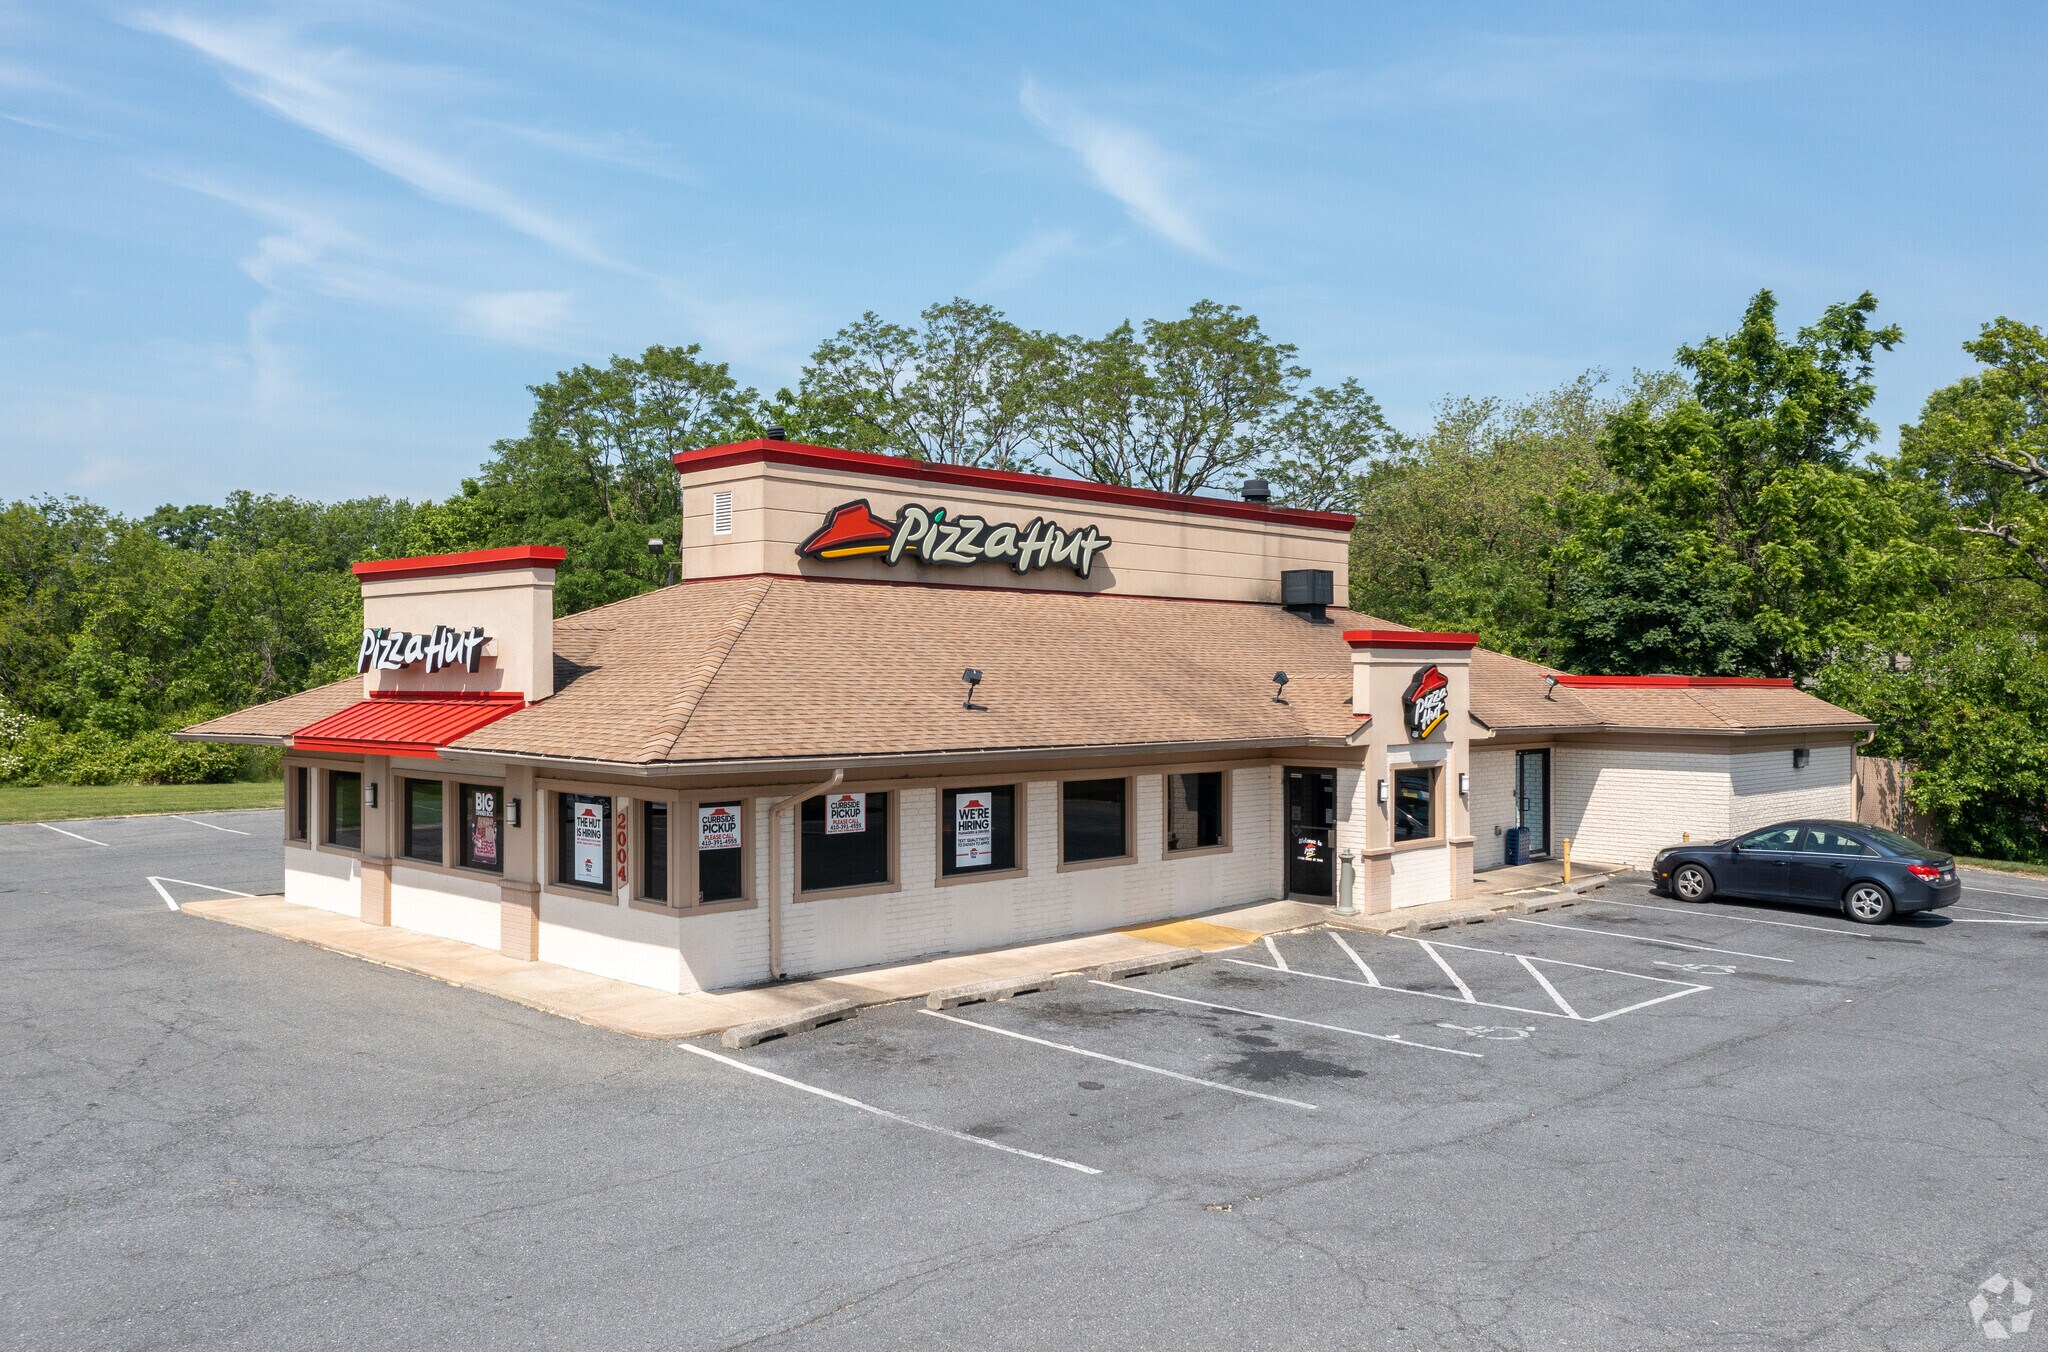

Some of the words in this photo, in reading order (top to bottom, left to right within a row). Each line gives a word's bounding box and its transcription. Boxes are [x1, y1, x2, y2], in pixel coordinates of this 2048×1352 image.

[889, 507, 1019, 564] Pizza
[1018, 520, 1110, 576] Hut
[357, 627, 424, 674] Pizza
[424, 625, 485, 674] Hut
[1415, 687, 1448, 725] Pizza
[1420, 701, 1445, 730] Hut
[475, 792, 494, 811] BIG
[830, 801, 861, 810] CURBSIDE
[701, 815, 736, 824] CURBSIDE
[831, 809, 861, 819] PICKUP
[958, 808, 990, 820] WE'RE
[576, 816, 588, 828] THE
[588, 818, 601, 829] HUT
[702, 823, 736, 834] PICKUP
[958, 819, 990, 831] HIRING
[576, 828, 582, 837] IS
[582, 828, 601, 839] HIRING
[616, 812, 627, 882] 2004
[701, 838, 738, 846] 410-391-4555
